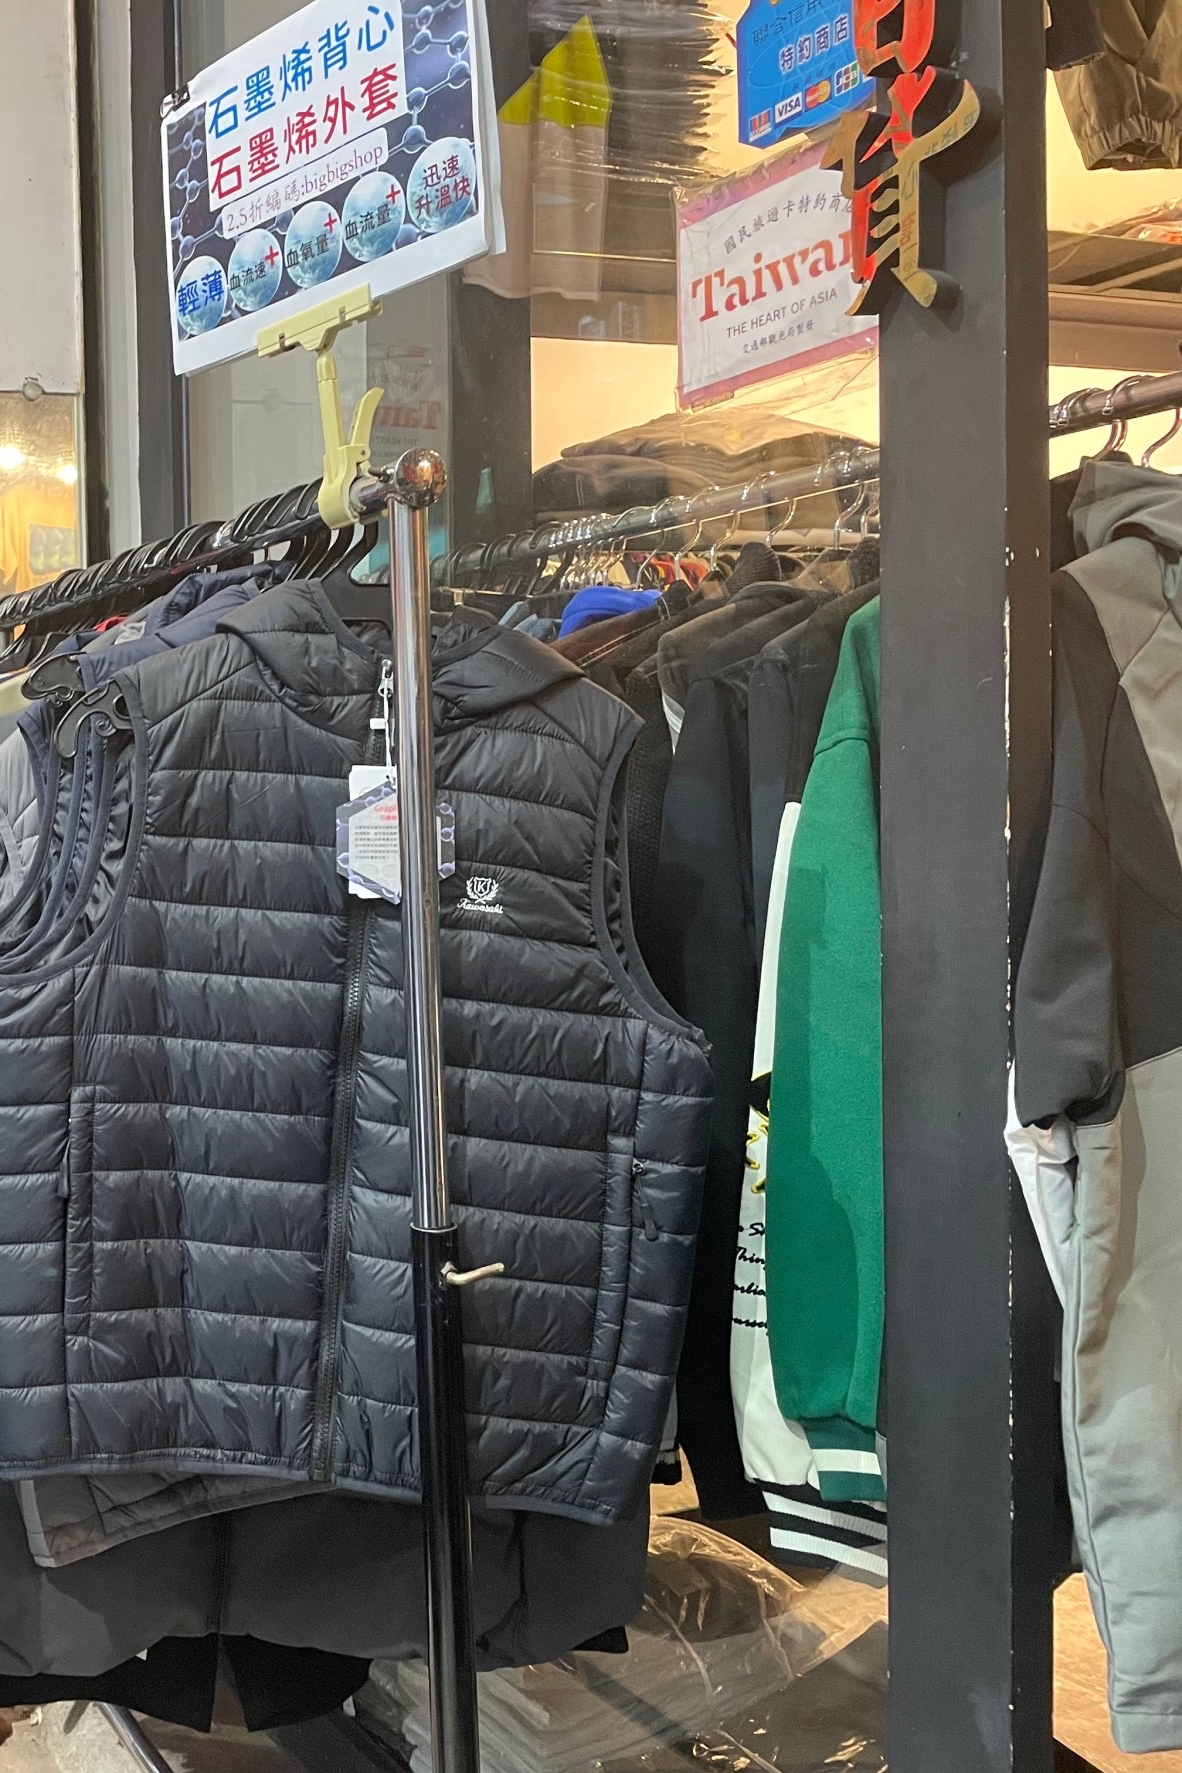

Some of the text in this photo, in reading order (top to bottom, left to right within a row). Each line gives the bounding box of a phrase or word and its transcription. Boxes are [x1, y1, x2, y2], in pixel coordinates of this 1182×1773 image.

[752, 0, 837, 46] 聯合信用
[780, 14, 849, 74] 特約商店
[208, 4, 395, 140] 石墨烯背心
[838, 70, 858, 86] JCB
[777, 98, 801, 118] VISA
[210, 63, 399, 200] 石墨烯外套
[422, 154, 460, 190] 迅速
[415, 176, 471, 219] 升溫快
[177, 269, 225, 316] 輕薄
[727, 288, 838, 338] THE HEART OF ASIA
